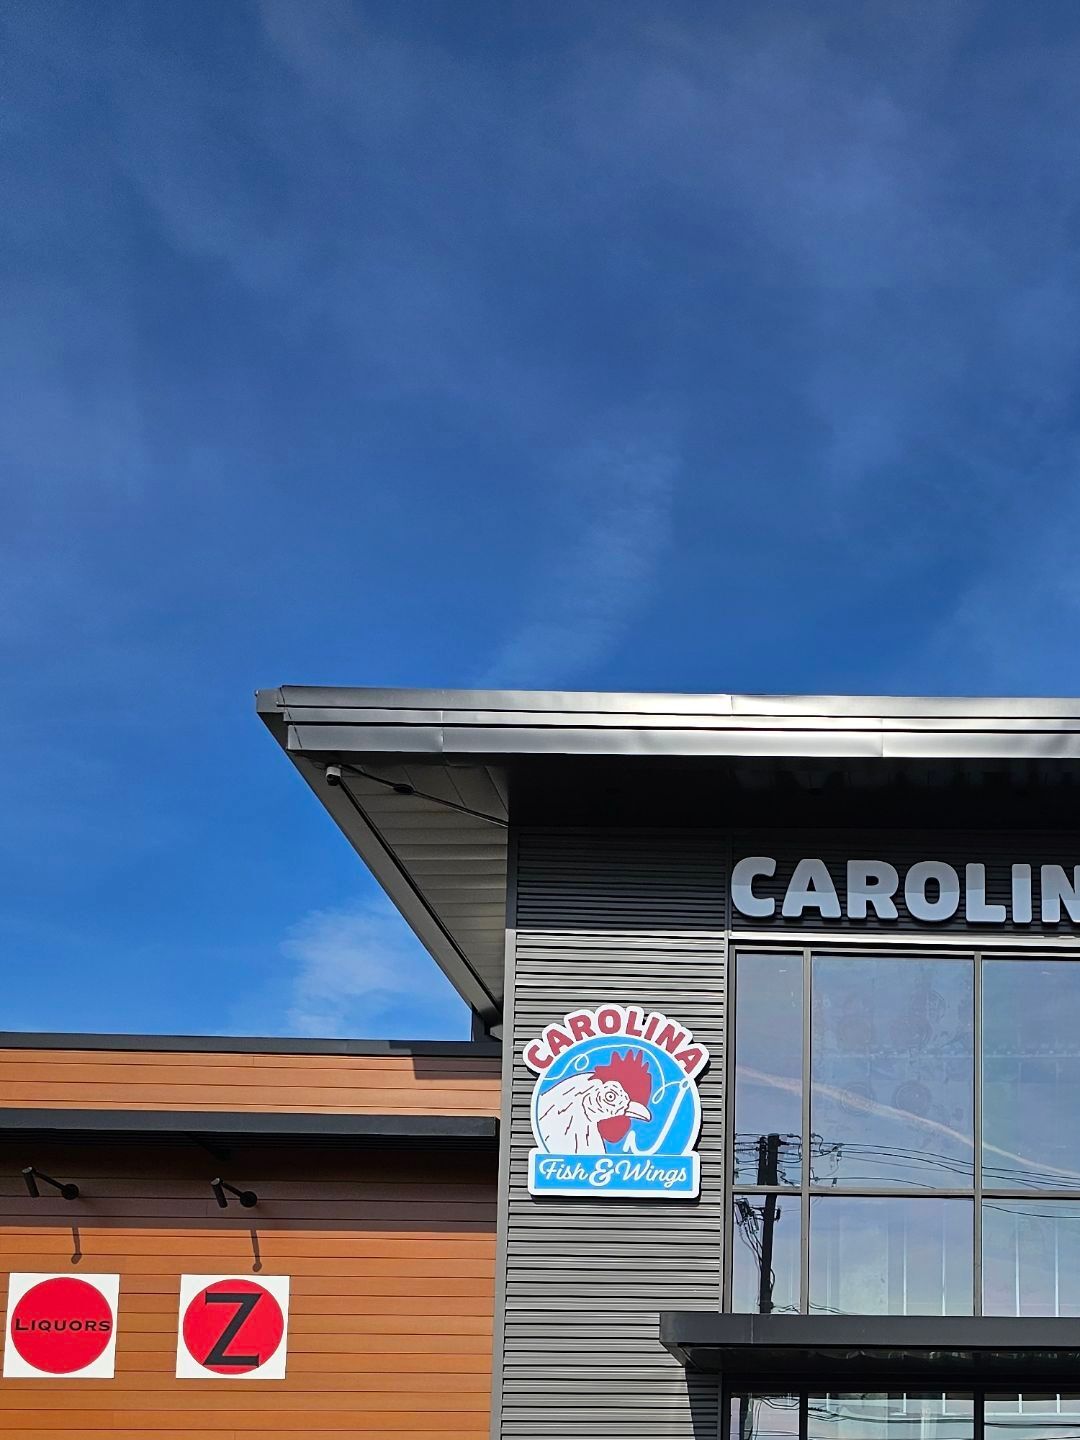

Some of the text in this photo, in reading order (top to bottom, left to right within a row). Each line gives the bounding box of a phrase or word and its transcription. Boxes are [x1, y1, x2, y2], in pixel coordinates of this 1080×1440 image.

[527, 1009, 704, 1075] CAROLINA
[538, 1158, 688, 1188] Fish & Wings
[15, 1318, 111, 1332] LIQUORS
[202, 1290, 263, 1368] Z
